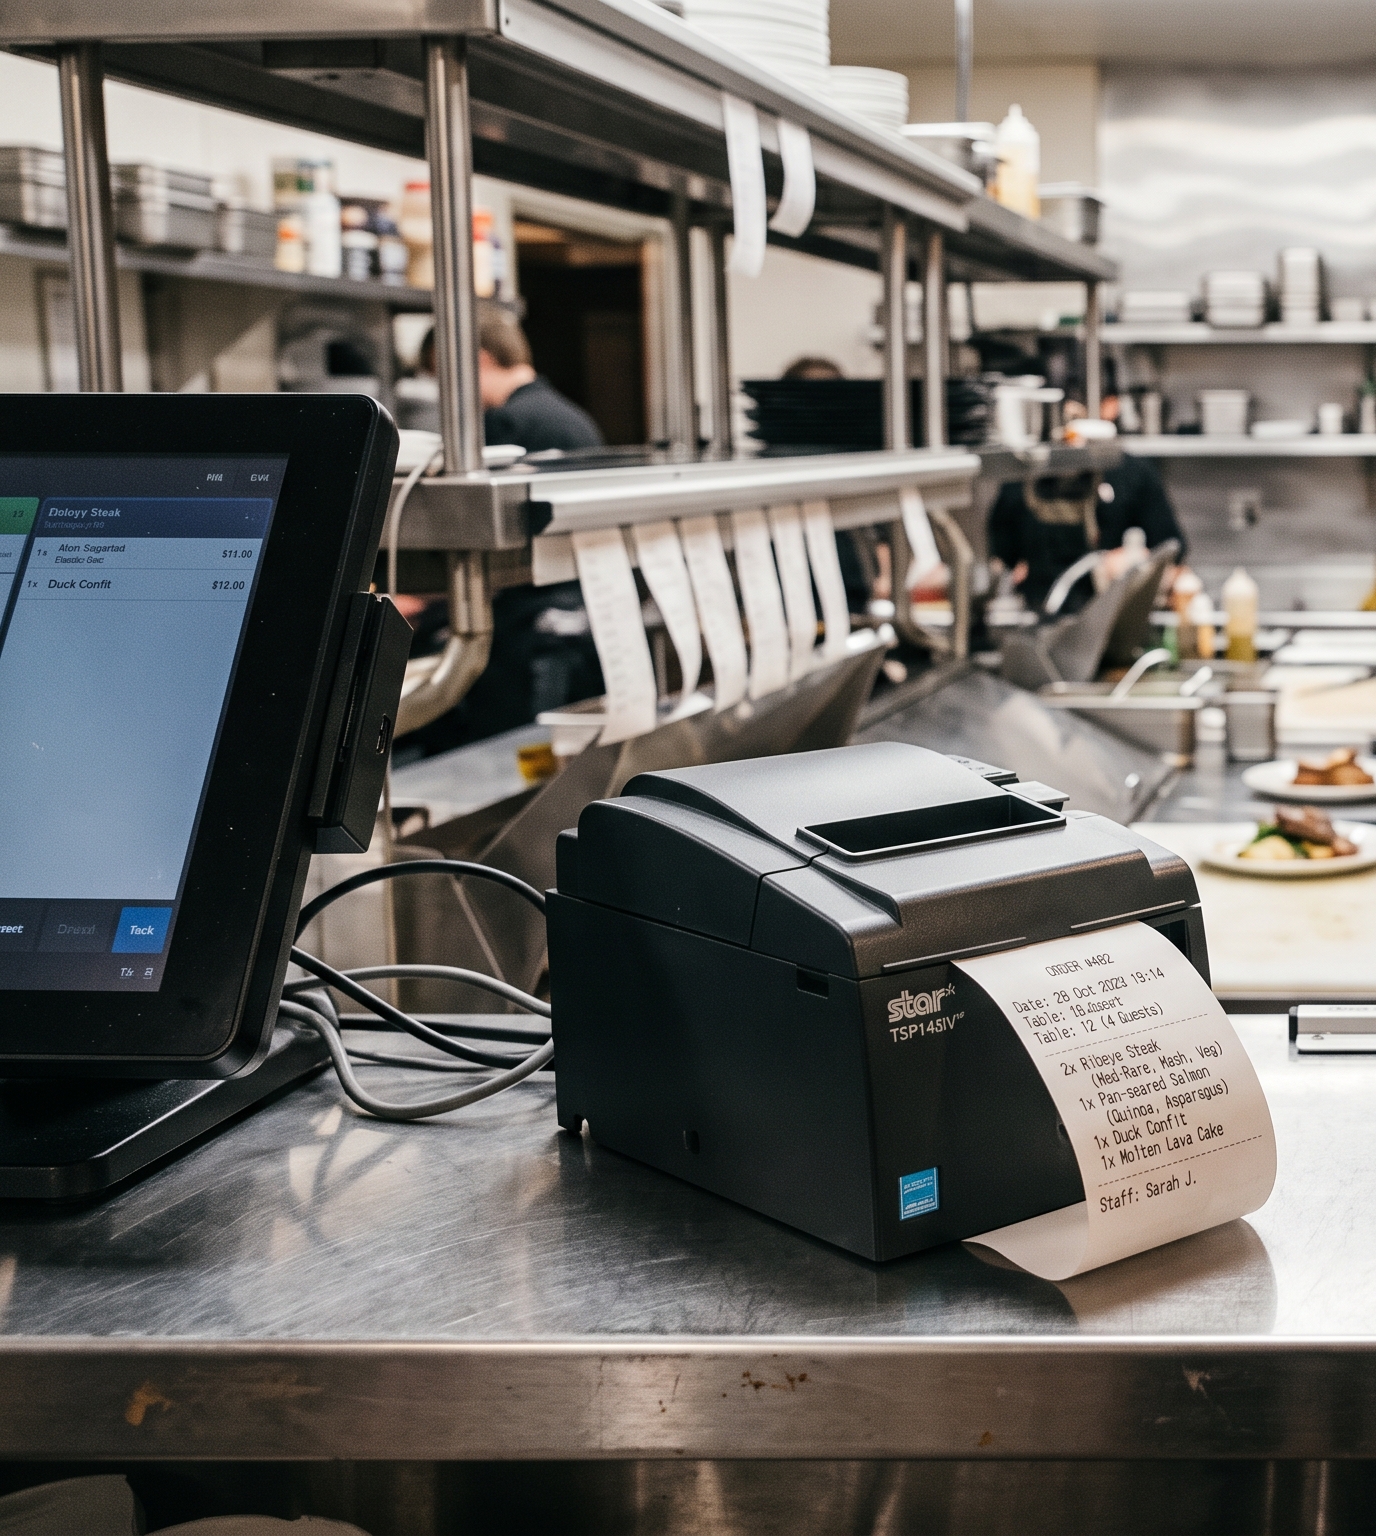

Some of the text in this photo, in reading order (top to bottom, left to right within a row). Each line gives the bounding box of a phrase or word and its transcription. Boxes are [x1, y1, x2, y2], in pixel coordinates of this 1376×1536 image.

[90, 507, 121, 517] Steak
[221, 550, 253, 560] $11.00
[47, 579, 112, 589] Duck Confit
[211, 580, 245, 591] $12.00
[887, 987, 946, 1023] star
[1012, 998, 1050, 1014] Date:
[1130, 967, 1165, 985] 19:14
[1023, 1010, 1066, 1029] Table:
[1034, 1026, 1076, 1045] Table:
[1081, 1019, 1097, 1034] 12
[1100, 1014, 1116, 1030] (4
[1060, 1039, 1162, 1077] 2x Ribeye Steak
[1158, 1050, 1193, 1071] Mash,
[1195, 1040, 1224, 1059] Veg)
[1079, 1066, 1211, 1112] 1x Pan-seared Salmon
[1106, 1102, 1160, 1127] (Quinoa,
[1094, 1135, 1110, 1150] 1x
[1112, 1125, 1143, 1145] Duck
[1101, 1123, 1225, 1170] 1x Molten Lava Cake
[1100, 1170, 1198, 1213] Staff: Sarah J.
